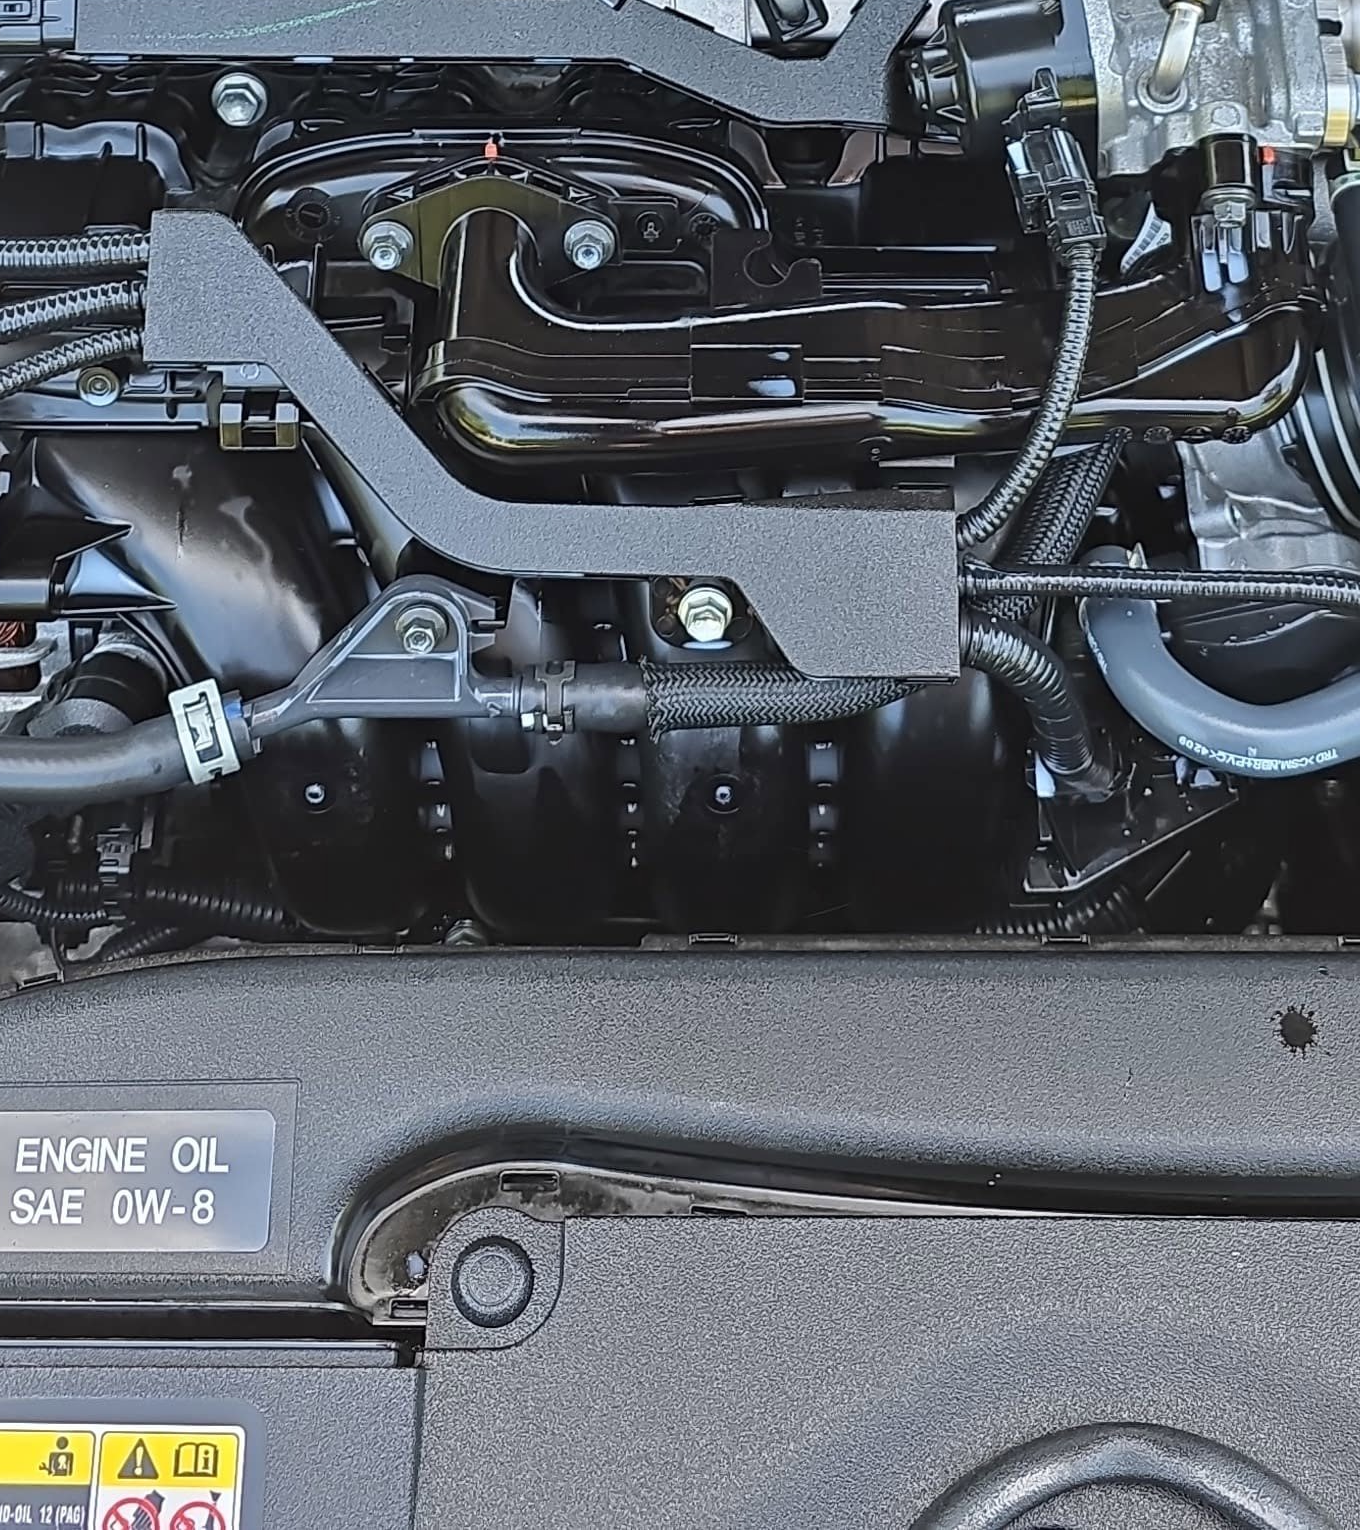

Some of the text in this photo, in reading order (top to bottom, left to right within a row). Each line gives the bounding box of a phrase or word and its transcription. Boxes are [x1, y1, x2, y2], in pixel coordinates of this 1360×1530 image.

[14, 1136, 230, 1174] ENGINE OIL
[9, 1188, 216, 1226] SAE 0W-8
[54, 1503, 86, 1527] (PAG)
